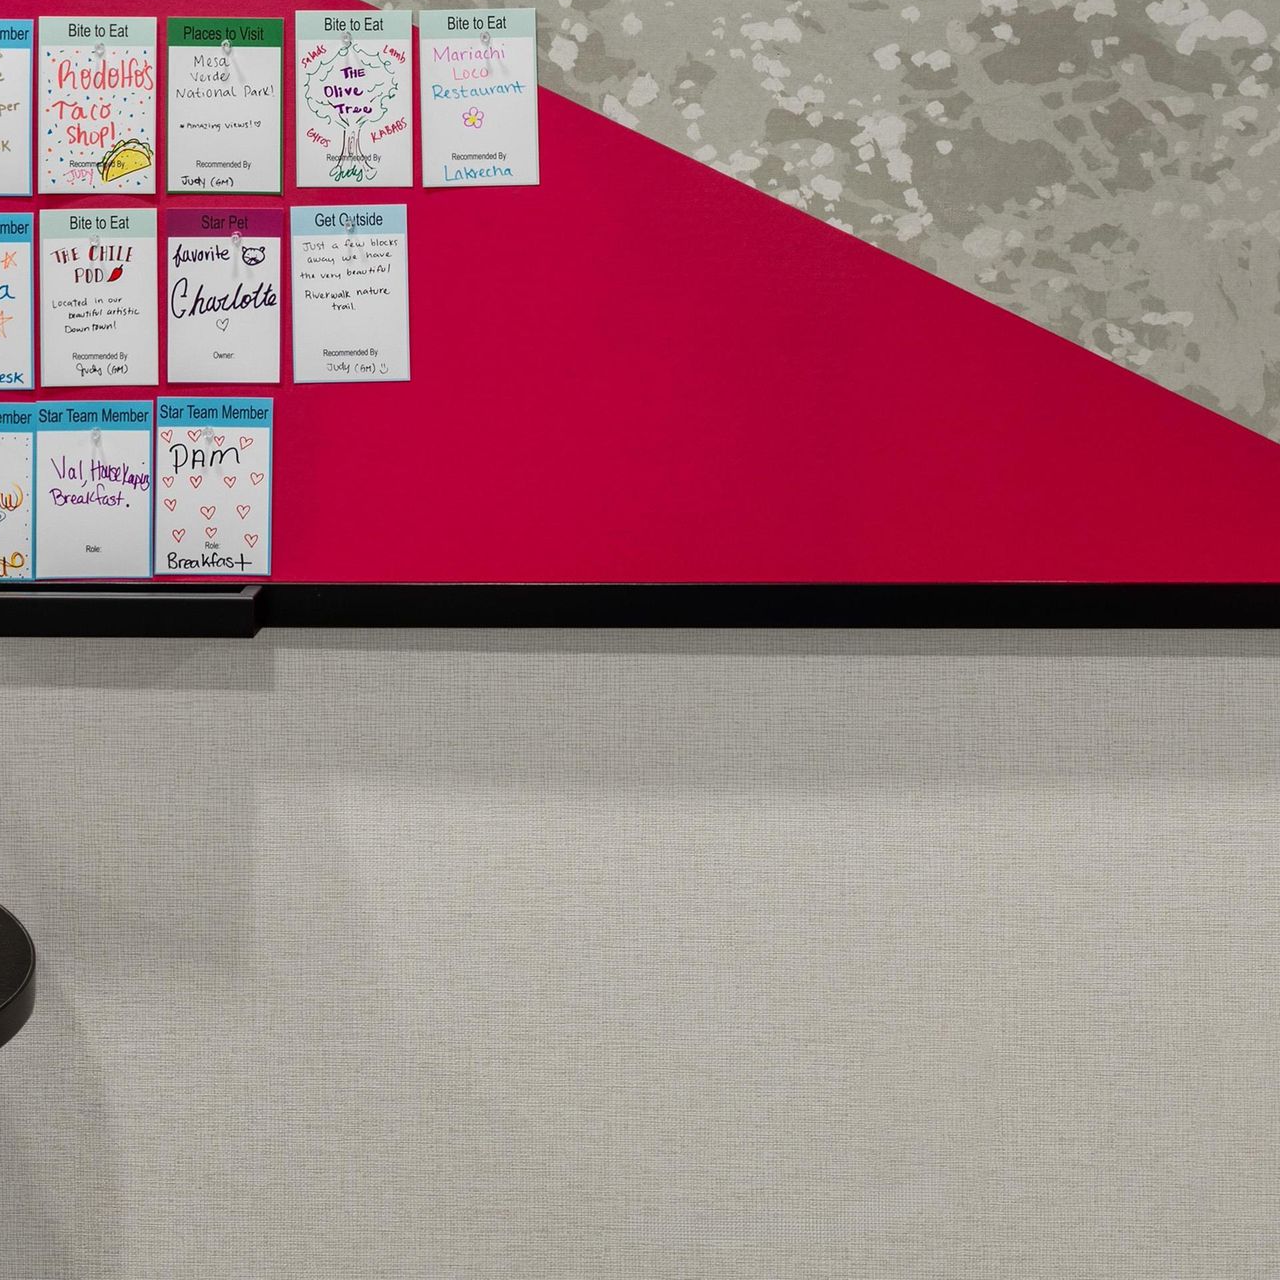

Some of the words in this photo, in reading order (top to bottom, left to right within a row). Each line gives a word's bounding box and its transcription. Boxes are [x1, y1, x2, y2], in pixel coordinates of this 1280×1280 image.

[323, 17, 346, 32] Bite
[349, 18, 361, 32] to
[364, 18, 384, 32] Eat
[447, 16, 470, 30] Bite
[473, 16, 484, 30] to
[487, 15, 507, 30] Eat
[68, 23, 91, 37] Bite
[95, 24, 106, 38] to
[110, 24, 129, 38] Eat
[183, 26, 222, 40] Places
[225, 26, 236, 40] to
[239, 27, 264, 40] Visit
[383, 44, 406, 64] Lamb
[433, 43, 505, 63] Mariachi
[193, 54, 230, 68] Mesa
[190, 71, 231, 83] Verde
[452, 67, 489, 81] Loco
[176, 86, 237, 99] National
[323, 85, 364, 99] Olive
[432, 81, 527, 100] Restaurant
[52, 100, 111, 121] Taco
[333, 103, 373, 115] Tree
[306, 127, 331, 148] Gyros
[196, 160, 241, 168] Recommended
[451, 153, 496, 162] Recommended
[181, 176, 206, 189] Judy
[69, 216, 92, 230] Bite
[96, 216, 107, 230] to
[110, 215, 130, 230] Eat
[201, 215, 226, 230] Star
[229, 215, 248, 230] Pet
[315, 213, 336, 227] Get
[302, 241, 325, 252] Just
[345, 239, 365, 248] few
[371, 239, 398, 247] blocks
[50, 247, 80, 264] THE
[88, 245, 133, 263] CHILE
[172, 243, 230, 268] favorite
[342, 254, 357, 262] we
[366, 251, 392, 259] have
[74, 268, 104, 284] POD
[299, 271, 315, 279] the
[320, 272, 341, 280] very
[346, 264, 391, 277] beautiful
[171, 277, 277, 319] Charlotte
[305, 289, 351, 300] Riverwalk
[356, 286, 391, 296] nature
[72, 352, 117, 361] Recommended
[322, 348, 369, 357] Recommended
[38, 409, 63, 423] Star
[66, 409, 98, 423] Team
[101, 409, 150, 423] Member
[160, 405, 184, 419] Star
[187, 405, 218, 419] Team
[222, 405, 270, 420] Member
[167, 551, 252, 572] Breakfast
